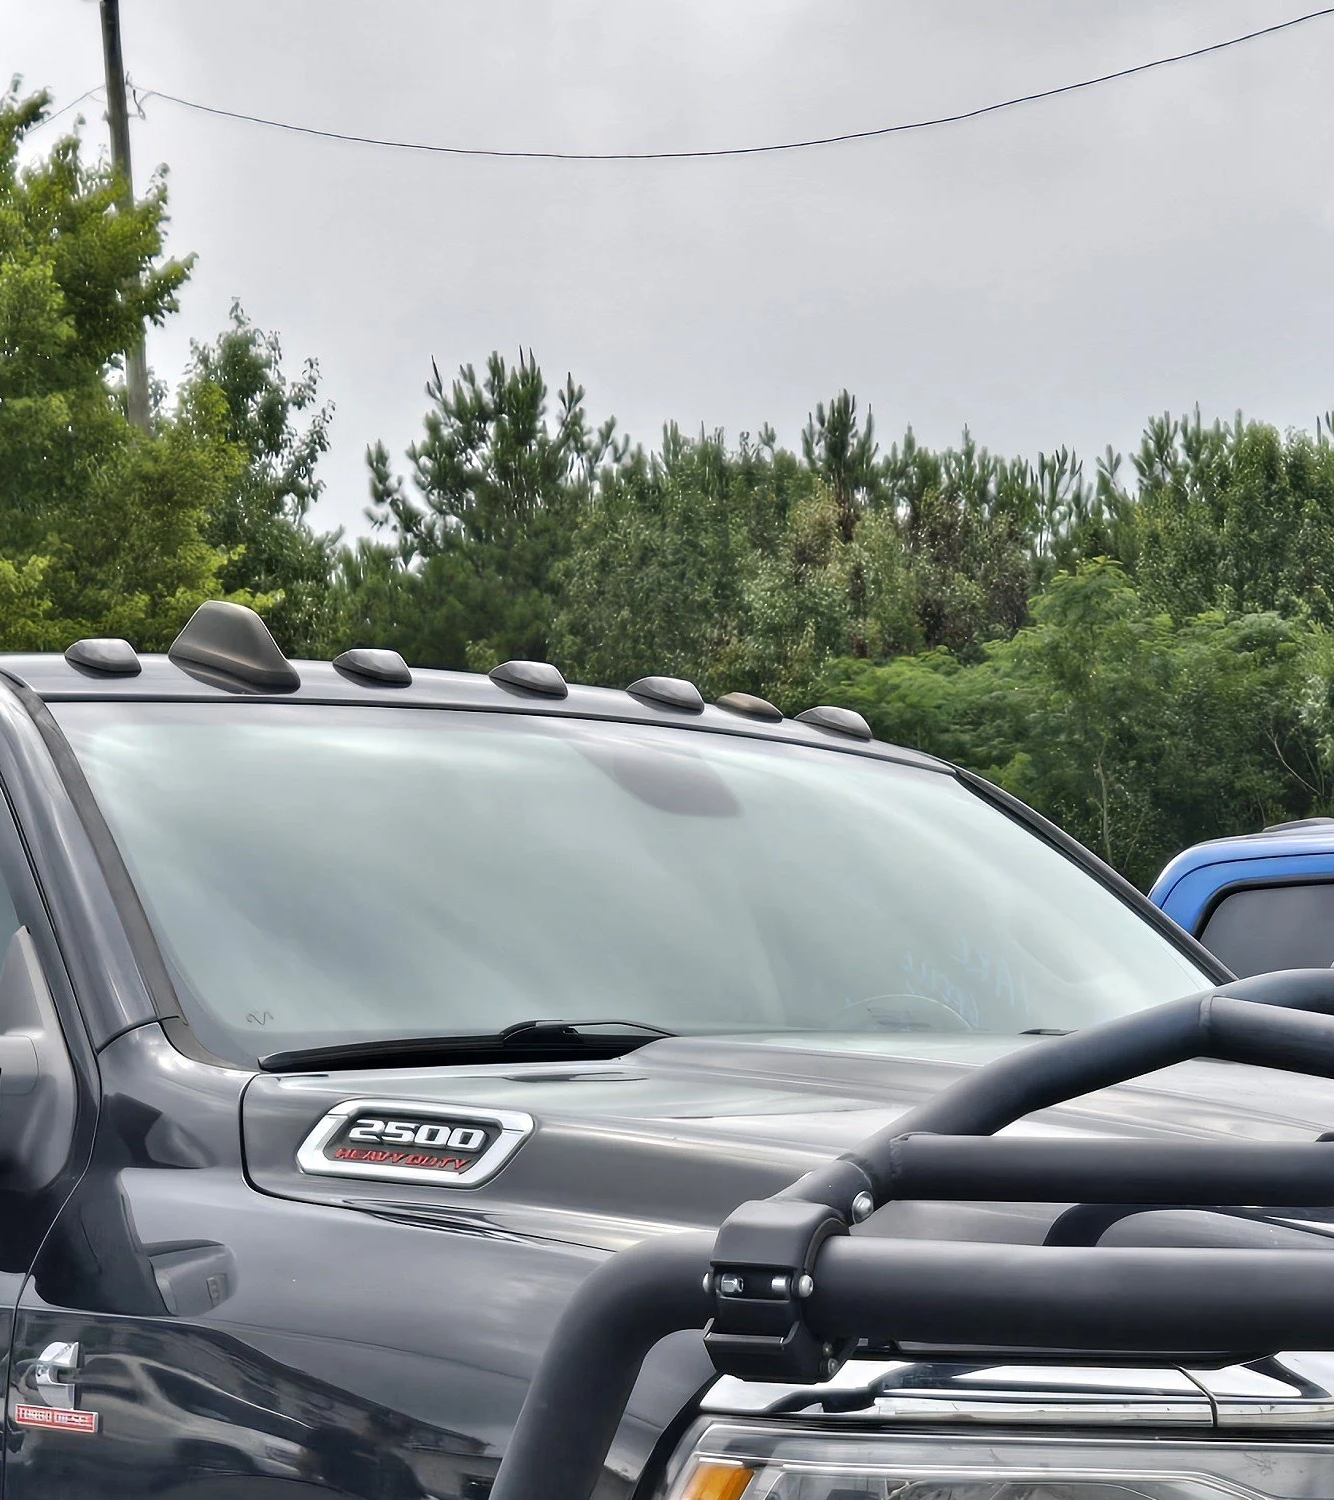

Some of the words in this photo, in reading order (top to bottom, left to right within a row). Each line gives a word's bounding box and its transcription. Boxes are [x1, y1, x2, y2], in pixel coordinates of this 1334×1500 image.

[349, 1119, 487, 1152] 2500
[333, 1148, 406, 1164] HEAVY
[406, 1154, 471, 1169] DUTY
